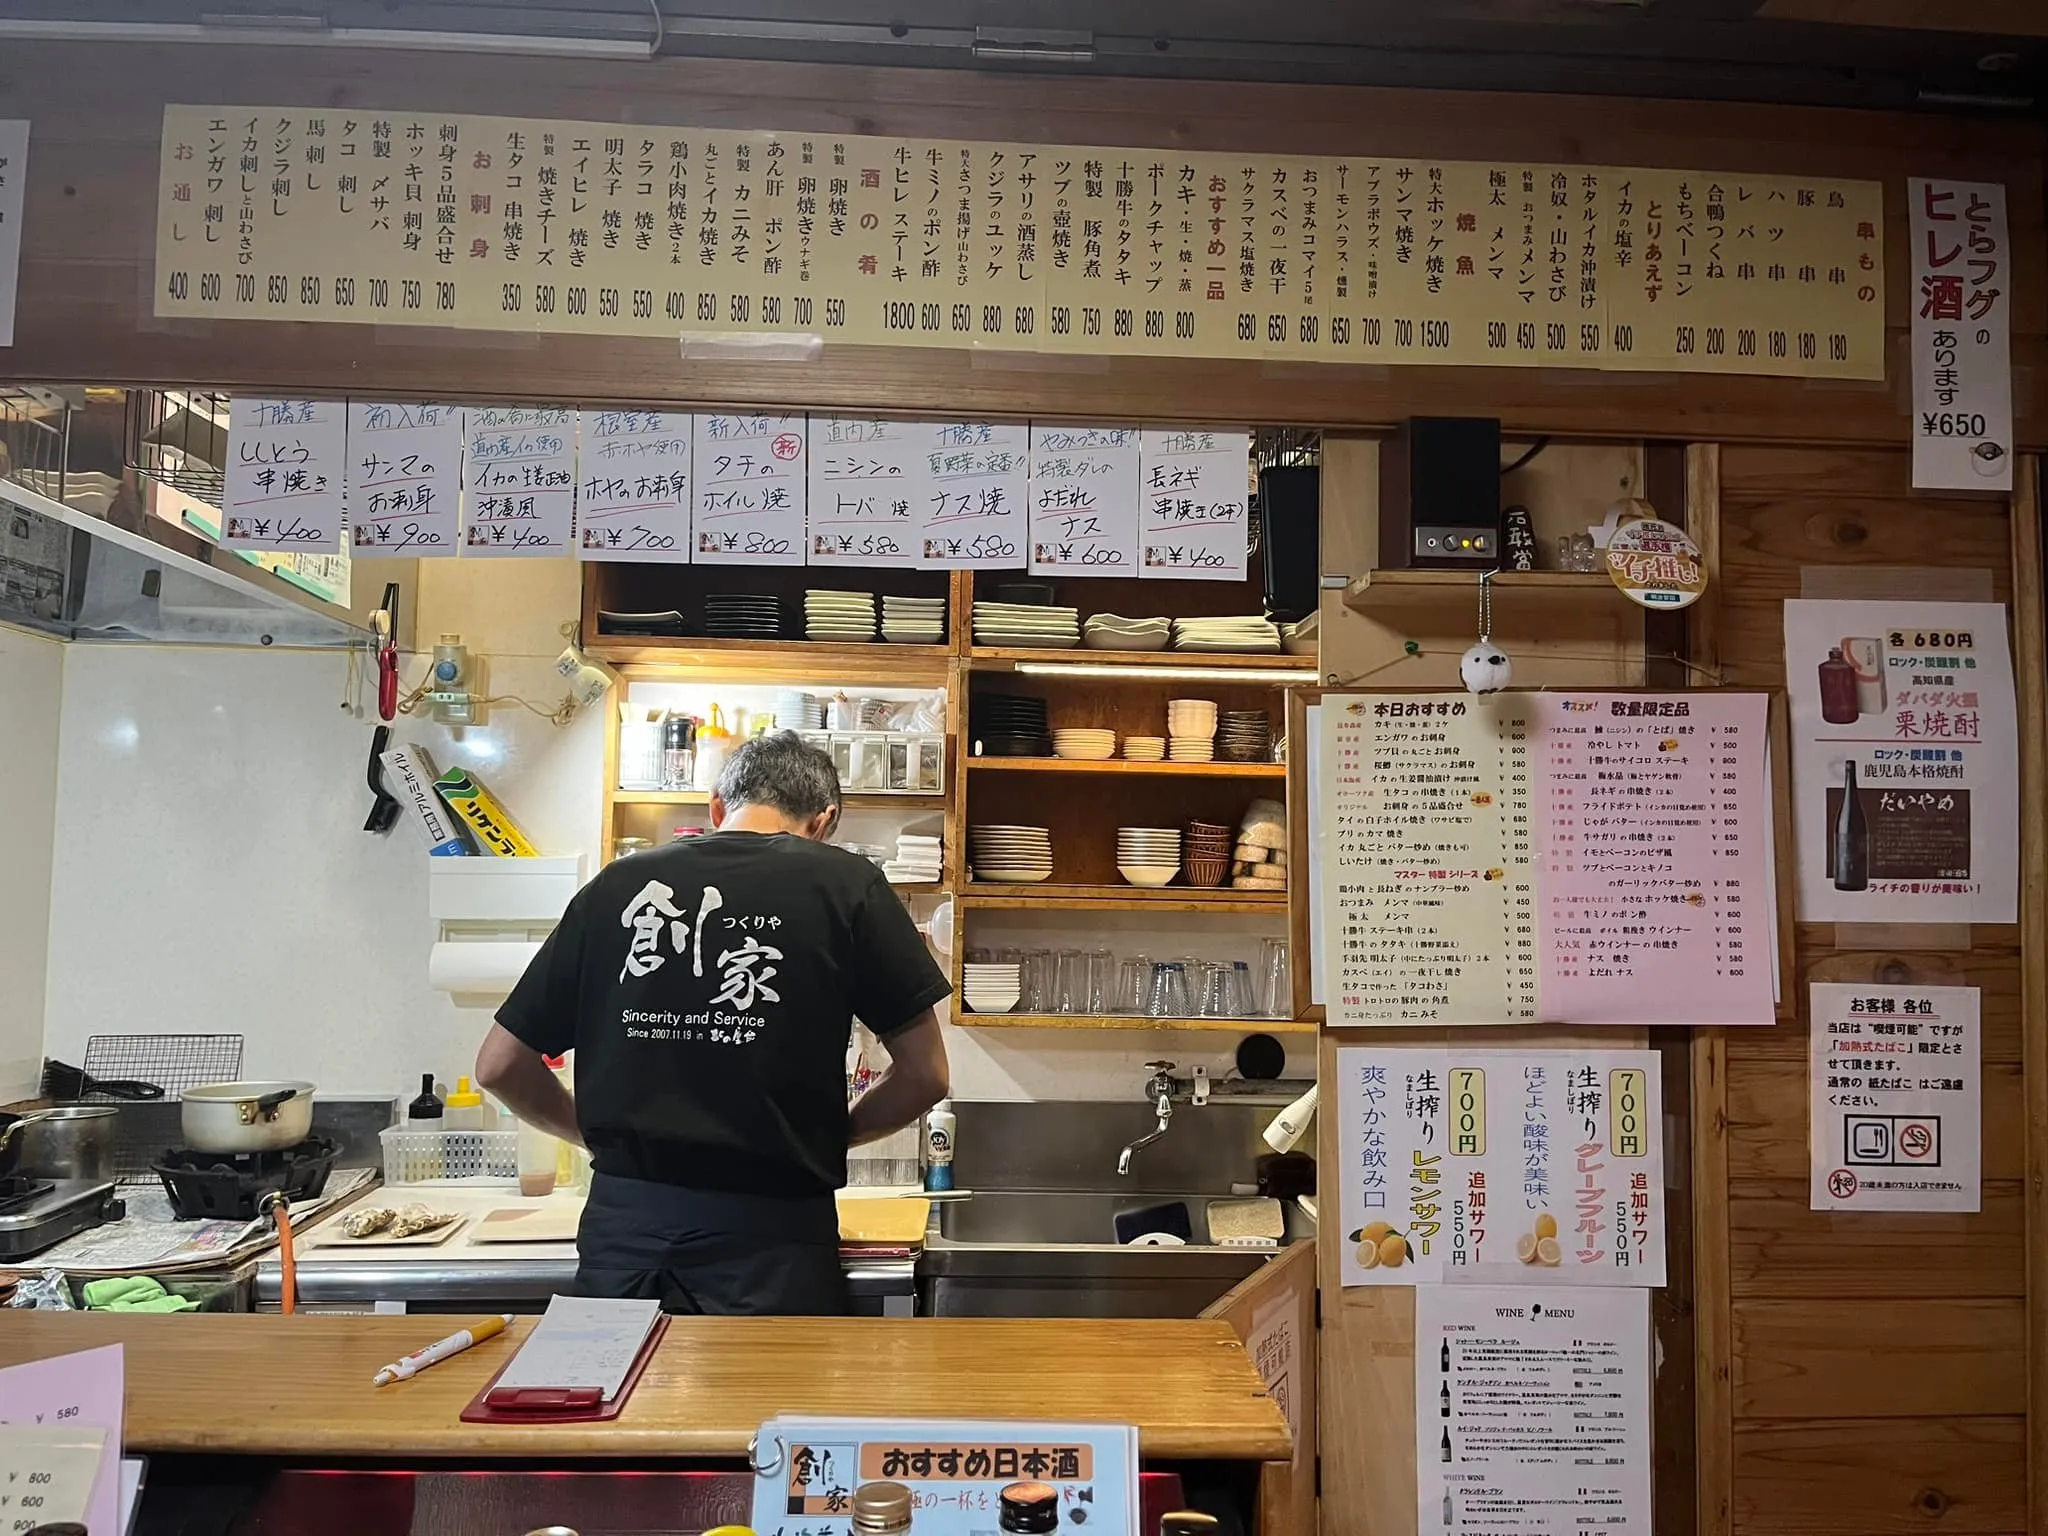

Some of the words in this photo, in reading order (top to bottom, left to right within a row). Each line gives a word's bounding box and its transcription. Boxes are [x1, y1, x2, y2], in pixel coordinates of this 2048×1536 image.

[272, 118, 291, 216] クジラ刺し
[172, 143, 193, 241] お通し
[238, 118, 258, 264] イカ刺しと山わさび
[435, 124, 457, 264] 刺身5品盛合せ
[470, 151, 491, 258] お刺身
[699, 143, 718, 265] 丸ごとイカ焼き
[858, 169, 880, 274] 酒の肴
[923, 149, 943, 277] 牛ミノのポン酢
[986, 152, 1004, 278] クジラのユッケ
[1018, 155, 1036, 280] アサリの酒蒸し
[1115, 161, 1134, 285] 十勝牛のタタキ
[1396, 168, 1413, 263] サンマ焼き
[1614, 181, 1632, 267] イカの塩辛
[1146, 163, 1164, 292] ポークチャップ
[1207, 175, 1226, 300] おすすめ一品
[1240, 168, 1255, 292] サクラマス塩焼き
[1271, 168, 1287, 294] カスベの一夜干
[1426, 168, 1444, 293] 特大ホッケ焼き
[1549, 172, 1567, 303] 冷奴・山わさび
[1581, 174, 1598, 308] ホタルイカ沖漬け
[1676, 182, 1694, 296] もちベーコン
[1706, 184, 1724, 278] 合鴨つくね
[1456, 213, 1476, 275] 焼魚
[1645, 200, 1662, 302] とりあえず
[1857, 222, 1875, 303] 串もの
[169, 272, 188, 300] 400
[236, 274, 254, 302] 700
[301, 276, 320, 304] 850
[436, 282, 454, 310] 780
[600, 289, 618, 316] 550
[666, 292, 684, 319] 400
[698, 293, 716, 320] 850
[763, 296, 780, 324] 580
[884, 302, 914, 329] 1800
[922, 304, 940, 331] 600
[983, 305, 1001, 332] 880
[1052, 307, 1070, 334] 580
[1115, 309, 1132, 336] 880
[1238, 314, 1256, 340] 680
[1301, 316, 1318, 343] 680
[1395, 319, 1412, 346] 700
[1421, 321, 1449, 347] 1500
[1581, 325, 1599, 351] 550
[1615, 325, 1632, 351] 400
[1677, 327, 1694, 353] 250
[1738, 329, 1755, 356] 200
[1769, 331, 1786, 357] 180
[1923, 413, 1985, 437] ¥650
[240, 441, 311, 464] ししとう
[362, 455, 434, 478] サンマの
[715, 455, 774, 476] タチの
[824, 458, 901, 474] ニシンの
[254, 471, 328, 494] 串焼き
[585, 471, 686, 502] ホヤのお刺身
[1147, 466, 1200, 488] 長ネギ
[370, 485, 436, 514] お刺身
[704, 488, 792, 510] ホイル焼
[931, 488, 1010, 516] ナス焼
[1040, 488, 1097, 507] よだれ
[1062, 517, 1102, 535] ナス
[1890, 632, 1904, 646] 各
[1915, 633, 1972, 648] 680円
[1375, 702, 1466, 717] 本日おすすめ
[1611, 702, 1689, 717] 数量限定品
[1896, 710, 1980, 738] 栗焼酎
[1618, 741, 1640, 749] トマト
[1865, 764, 1963, 778] 鹿児島本格焼酎
[1340, 857, 1372, 865] しいたけ
[1449, 870, 1478, 878] シリーズ
[723, 916, 781, 930] つくりや
[622, 1009, 680, 1026] Sincerity
[685, 1011, 709, 1024] and
[714, 1011, 765, 1027] Service
[1851, 998, 1895, 1013] お客様
[1903, 999, 1933, 1014] 各位
[627, 1027, 648, 1038] Since
[651, 1029, 691, 1039] 2007.11.19
[1828, 1023, 1861, 1033] 当店は
[1929, 1025, 1963, 1036] ですが
[1828, 1076, 1862, 1088] 通常の
[1869, 1078, 1912, 1088] 紙たばこ
[1416, 1070, 1440, 1144] 生搾り
[1459, 1073, 1476, 1153] 700円
[1577, 1066, 1602, 1140] 生搾り
[1362, 1065, 1386, 1208] 爽やかな飲み口
[1524, 1067, 1549, 1209] ほどよい酸味が美味い
[1410, 1151, 1442, 1255] レモンサワー
[1468, 1172, 1485, 1263] 追加サワー
[1453, 1201, 1465, 1265] 550円
[1496, 1309, 1524, 1317] WINE
[1545, 1310, 1574, 1318] MENU
[57, 1406, 78, 1419] 580
[882, 1448, 1079, 1479] おすすめ日本酒
